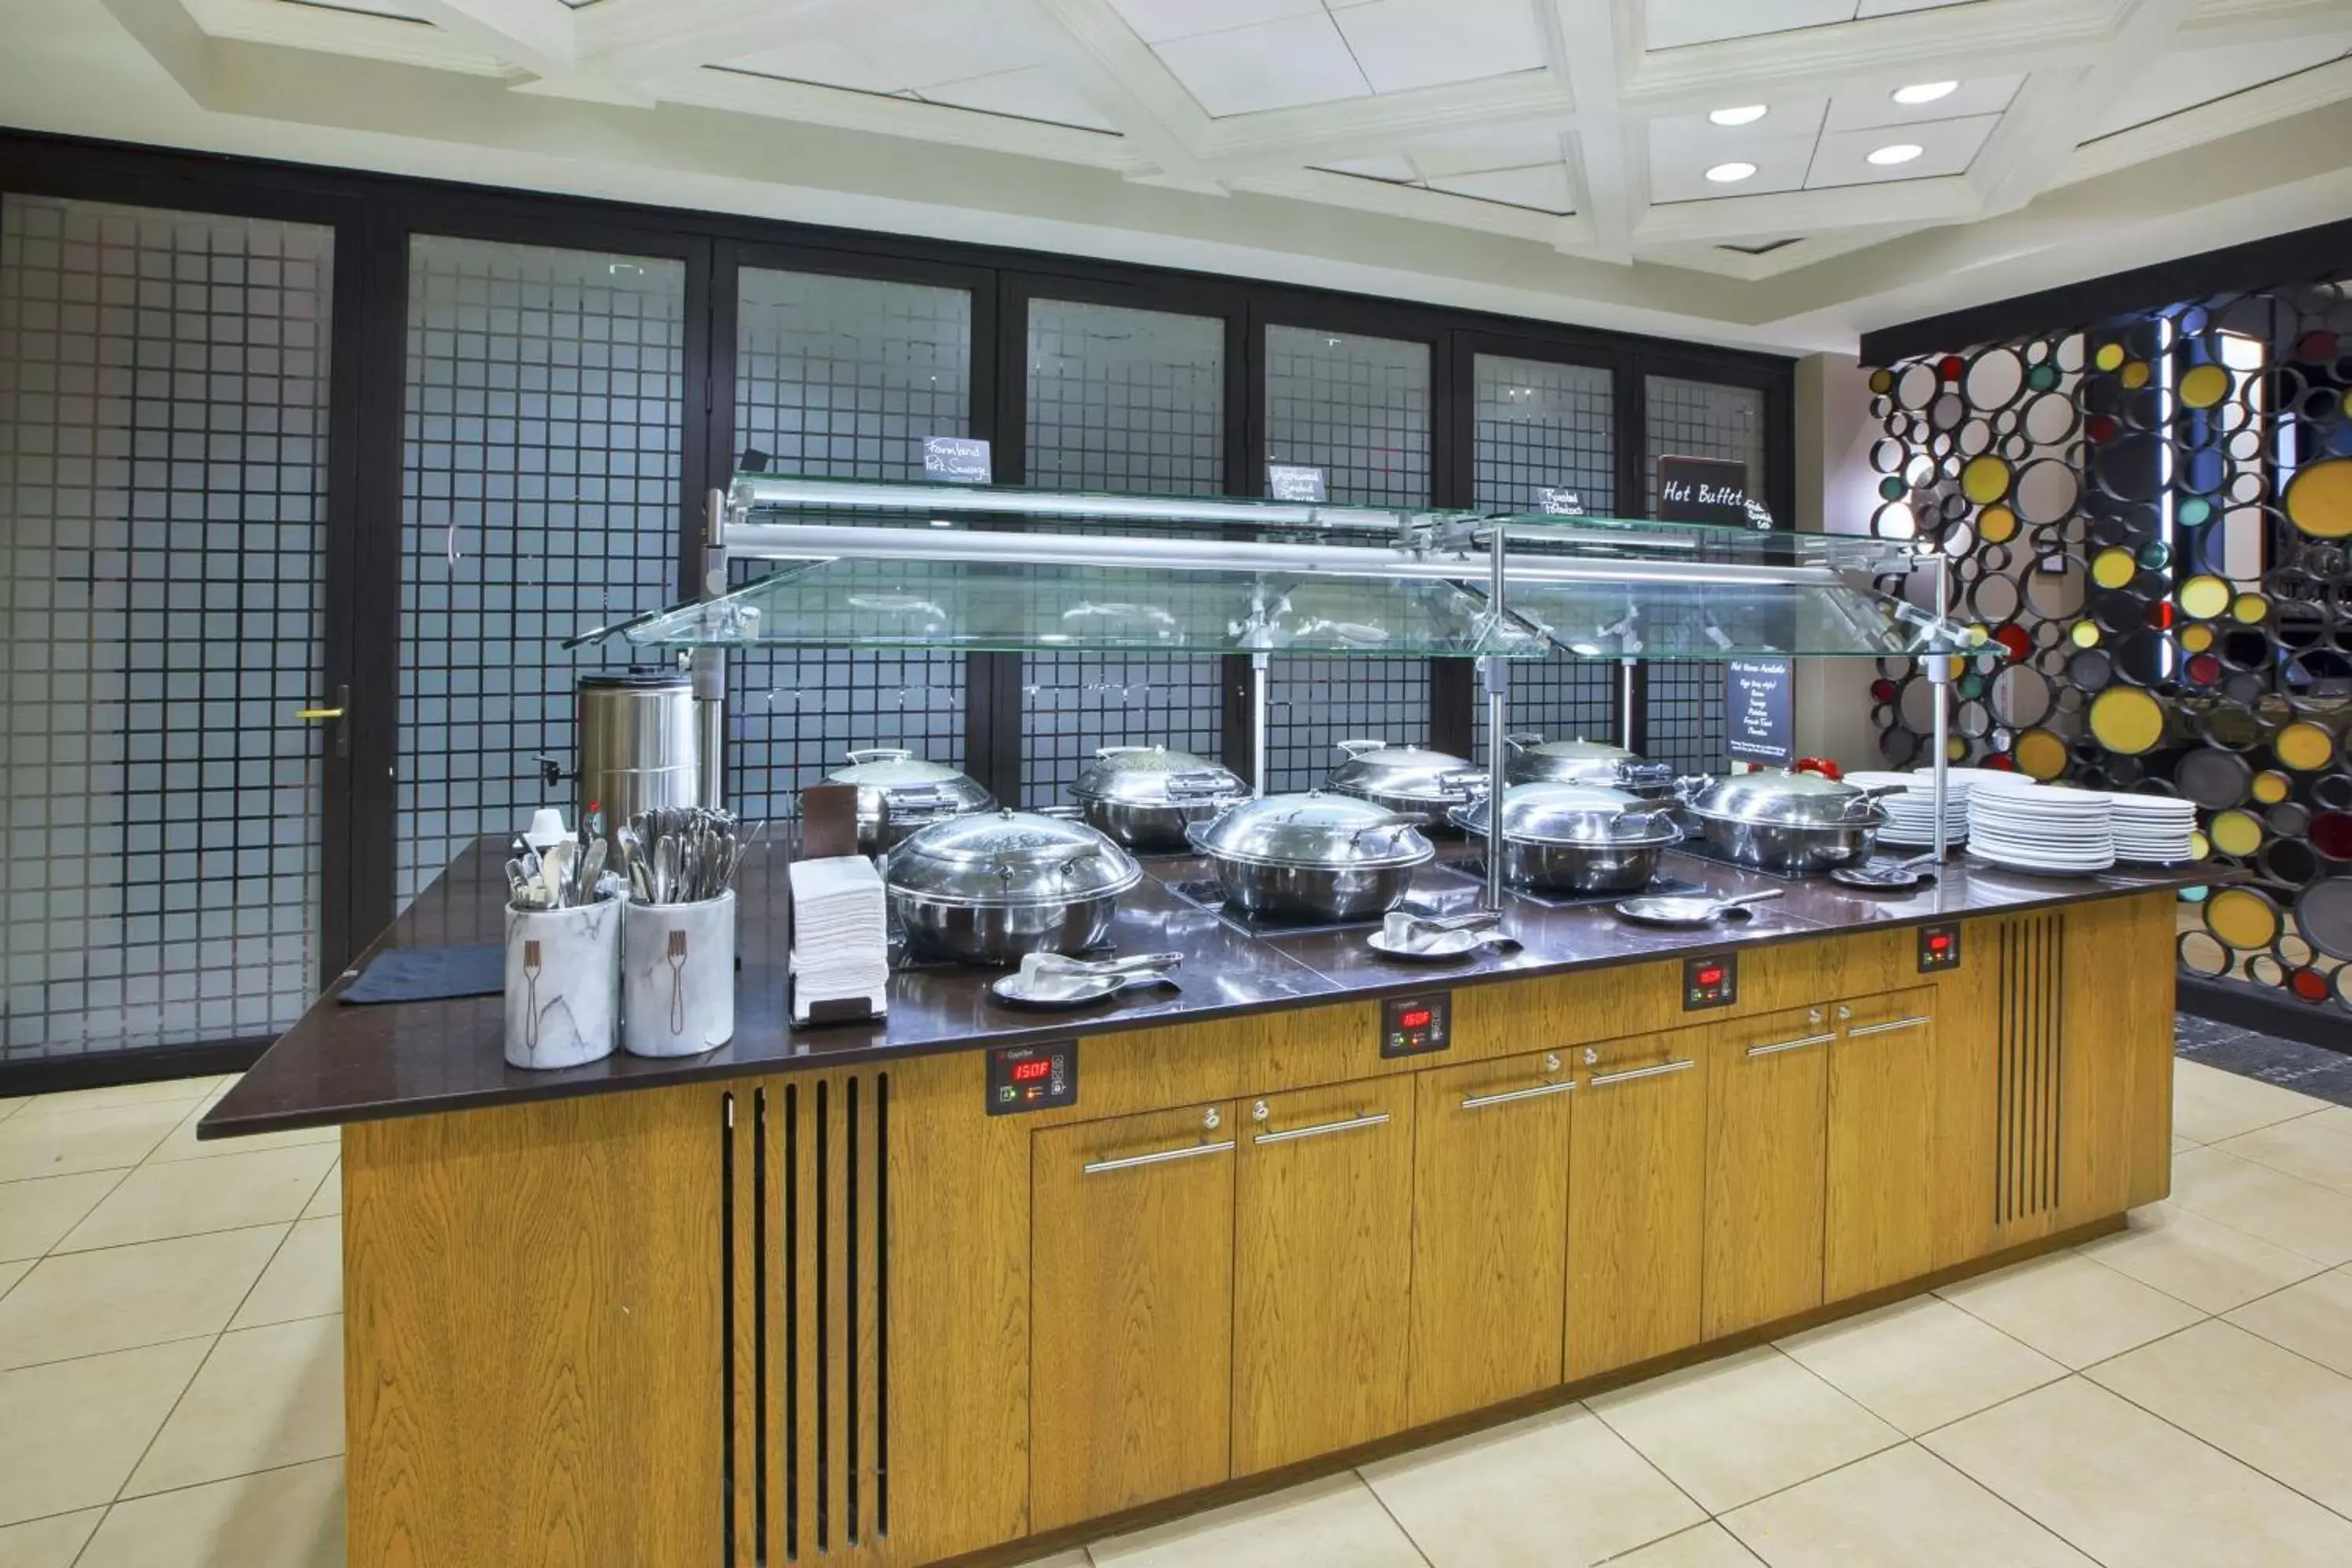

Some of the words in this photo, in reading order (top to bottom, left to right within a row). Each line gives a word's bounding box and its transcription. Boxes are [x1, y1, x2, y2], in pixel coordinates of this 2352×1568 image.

[926, 438, 979, 456] Farmland
[1664, 481, 1691, 502] Hot
[1698, 484, 1743, 506] Buffet
[1015, 1061, 1049, 1080] 150F
